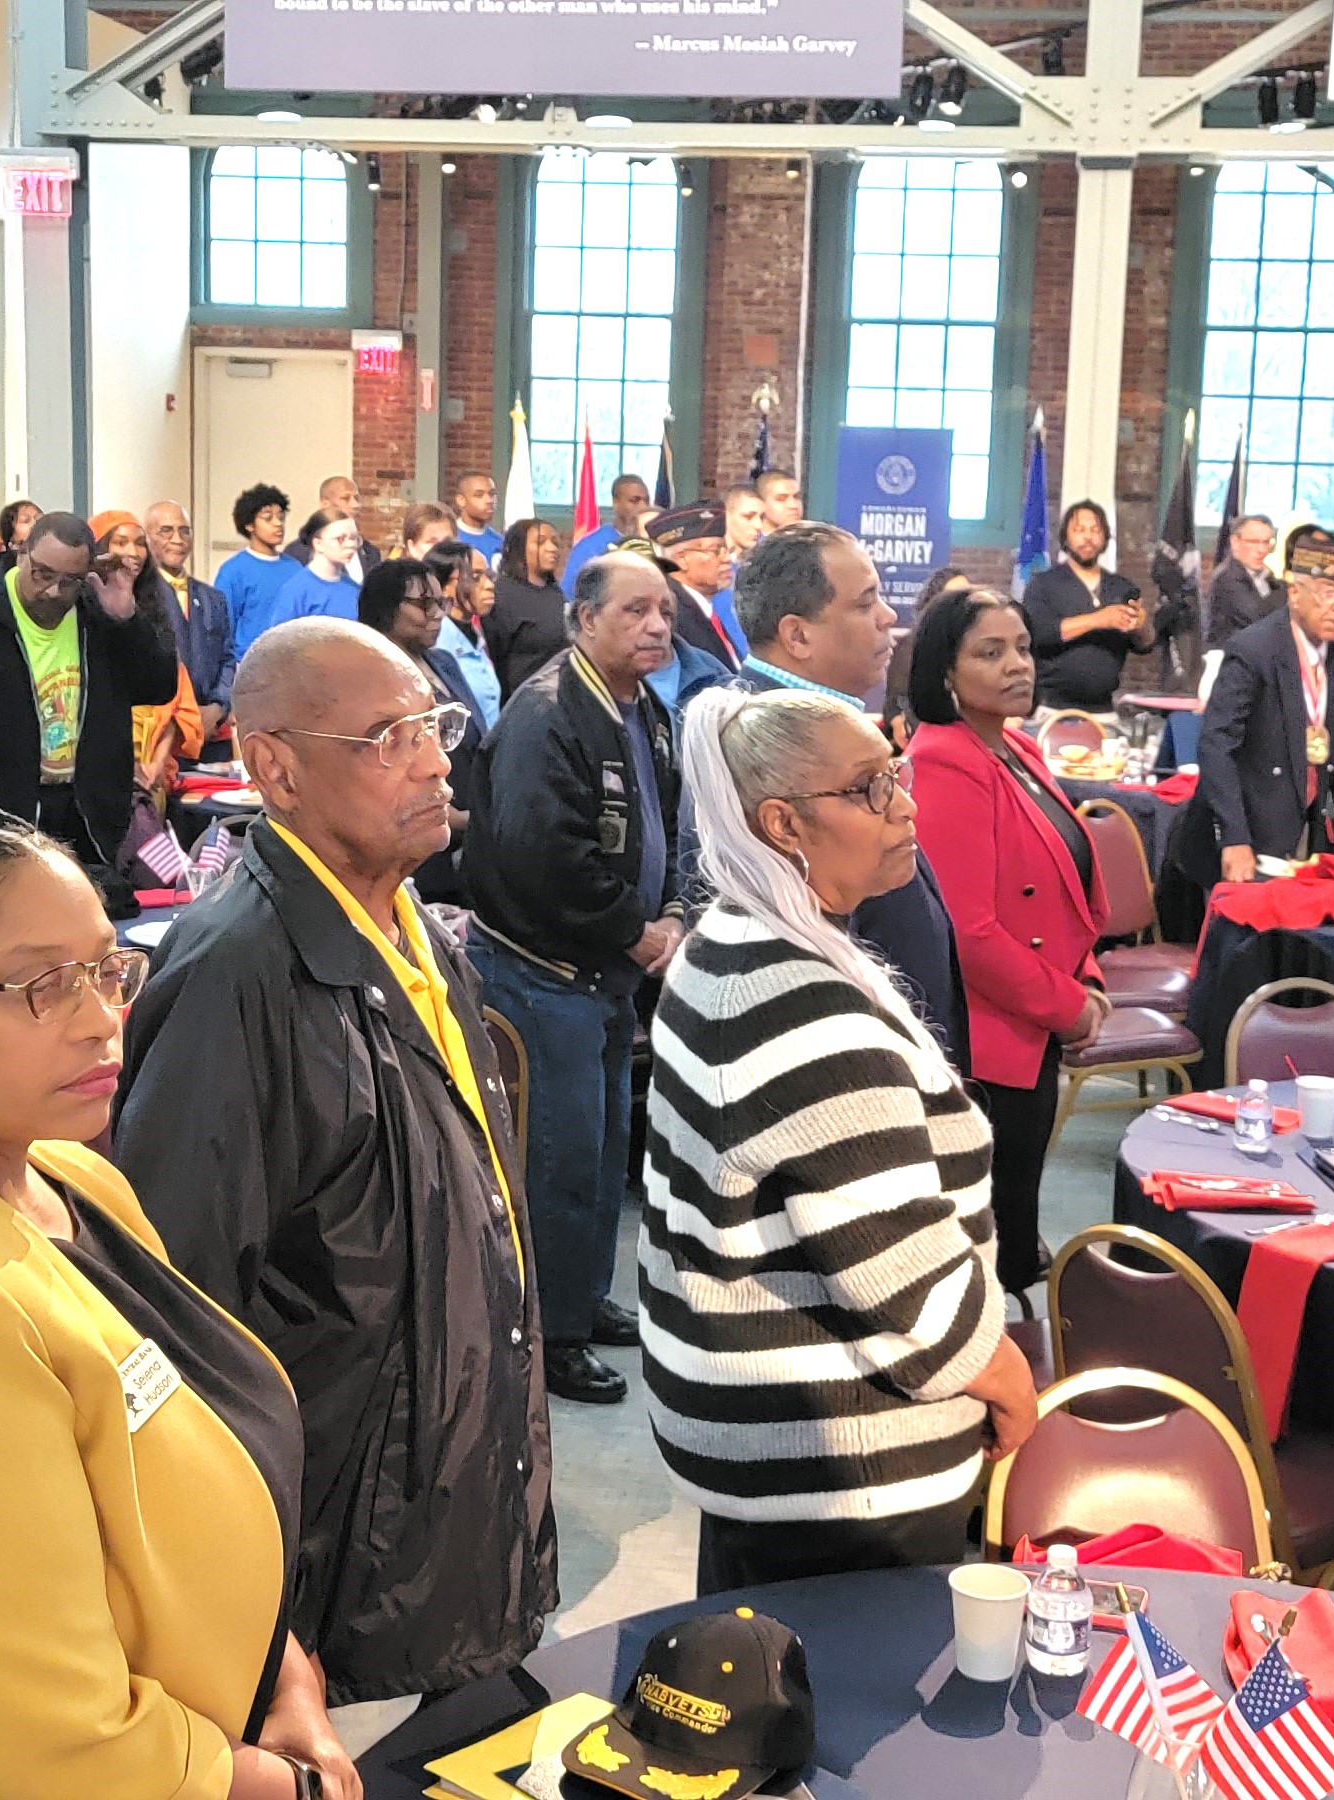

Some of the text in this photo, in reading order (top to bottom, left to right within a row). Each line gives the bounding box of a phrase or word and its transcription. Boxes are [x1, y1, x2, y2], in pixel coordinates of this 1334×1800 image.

[275, 0, 328, 10] bound
[332, 0, 349, 11] to
[353, 0, 373, 11] be
[376, 0, 404, 11] the
[407, 0, 450, 11] slave
[453, 0, 471, 12] of
[477, 0, 504, 12] the
[508, 0, 555, 13] other
[558, 2, 597, 13] man
[600, 1, 637, 13] who
[641, 2, 679, 13] uses
[683, 0, 710, 13] his
[652, 34, 720, 52] Marcus
[723, 34, 790, 53] Mosiah
[792, 35, 858, 57] Garvey
[10, 170, 64, 213] EXIT
[359, 345, 395, 373] EXIT
[860, 512, 927, 538] MORGAN
[143, 1374, 174, 1406] Hudson
[662, 1707, 718, 1734] Commander
